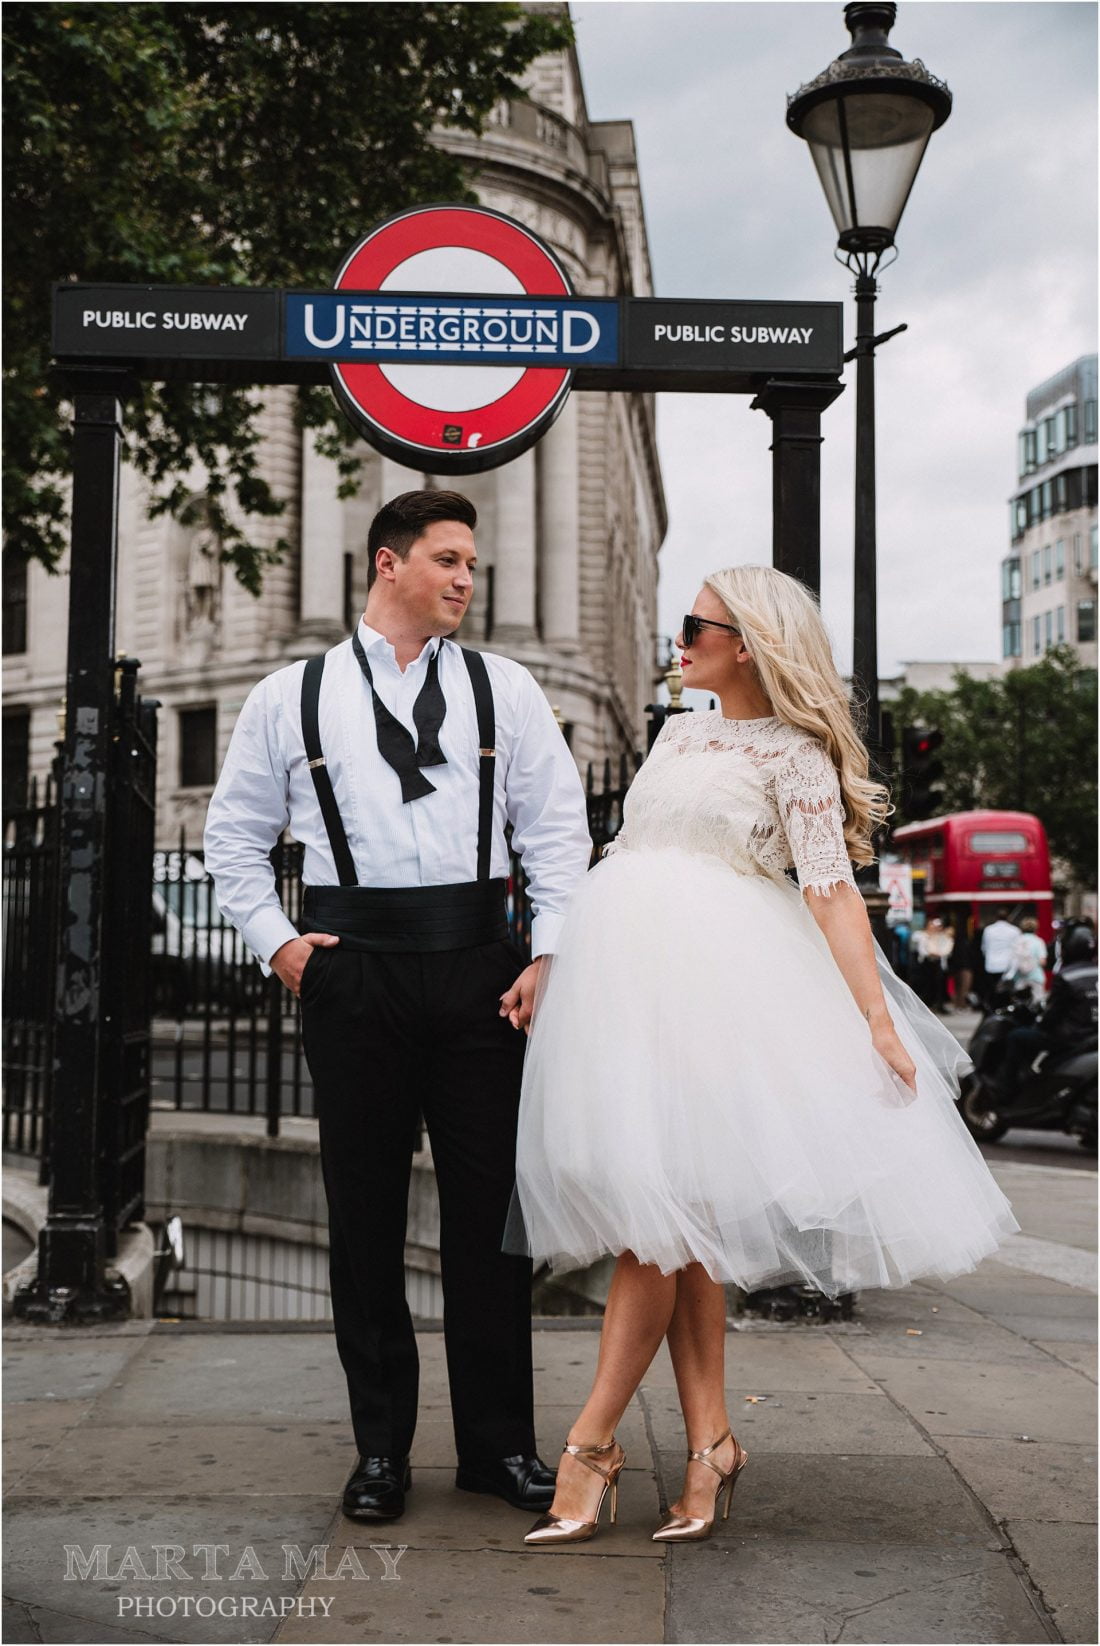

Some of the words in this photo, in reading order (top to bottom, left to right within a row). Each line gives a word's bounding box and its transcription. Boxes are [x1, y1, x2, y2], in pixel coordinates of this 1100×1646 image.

[82, 310, 157, 329] PUBLIC
[162, 312, 249, 331] SUBWAY
[304, 304, 601, 354] UNDERGROUND
[654, 324, 725, 343] PUBLIC
[730, 325, 814, 345] SUBWAY
